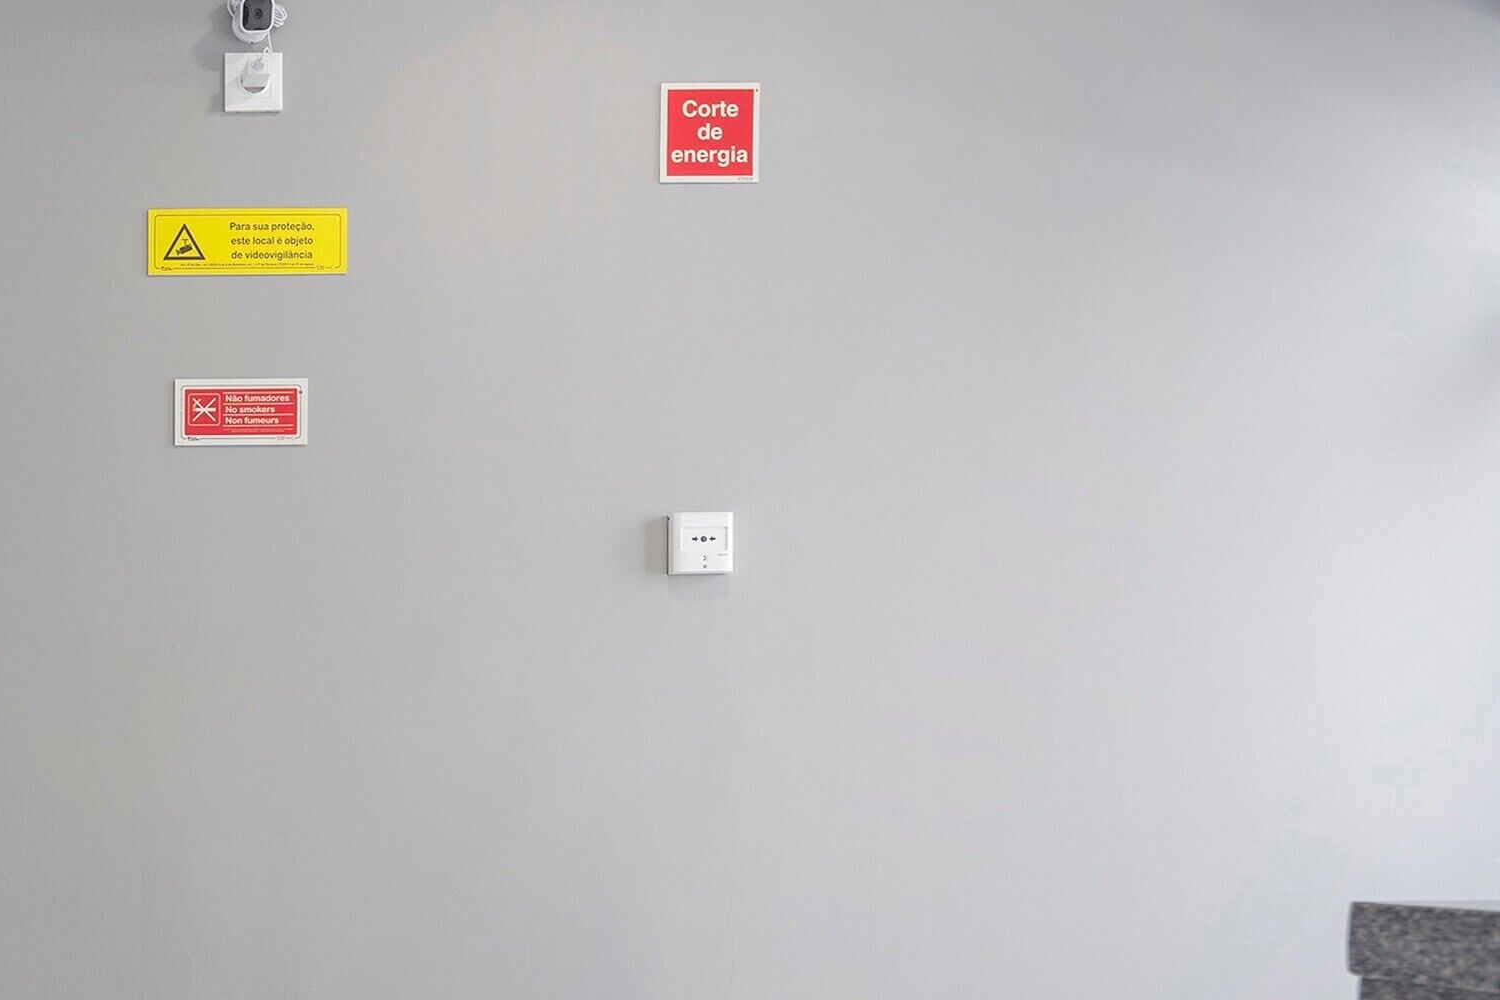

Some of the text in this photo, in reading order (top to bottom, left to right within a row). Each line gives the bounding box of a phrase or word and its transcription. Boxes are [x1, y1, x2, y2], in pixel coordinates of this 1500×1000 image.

[682, 99, 739, 118] Corte
[697, 122, 723, 141] de
[671, 145, 749, 168] energia
[229, 222, 251, 231] Para
[231, 236, 314, 248] este local é objeto
[231, 250, 313, 262] de videovigilância
[225, 394, 290, 402] Não fumadores
[225, 417, 280, 425] Non fumeurs
